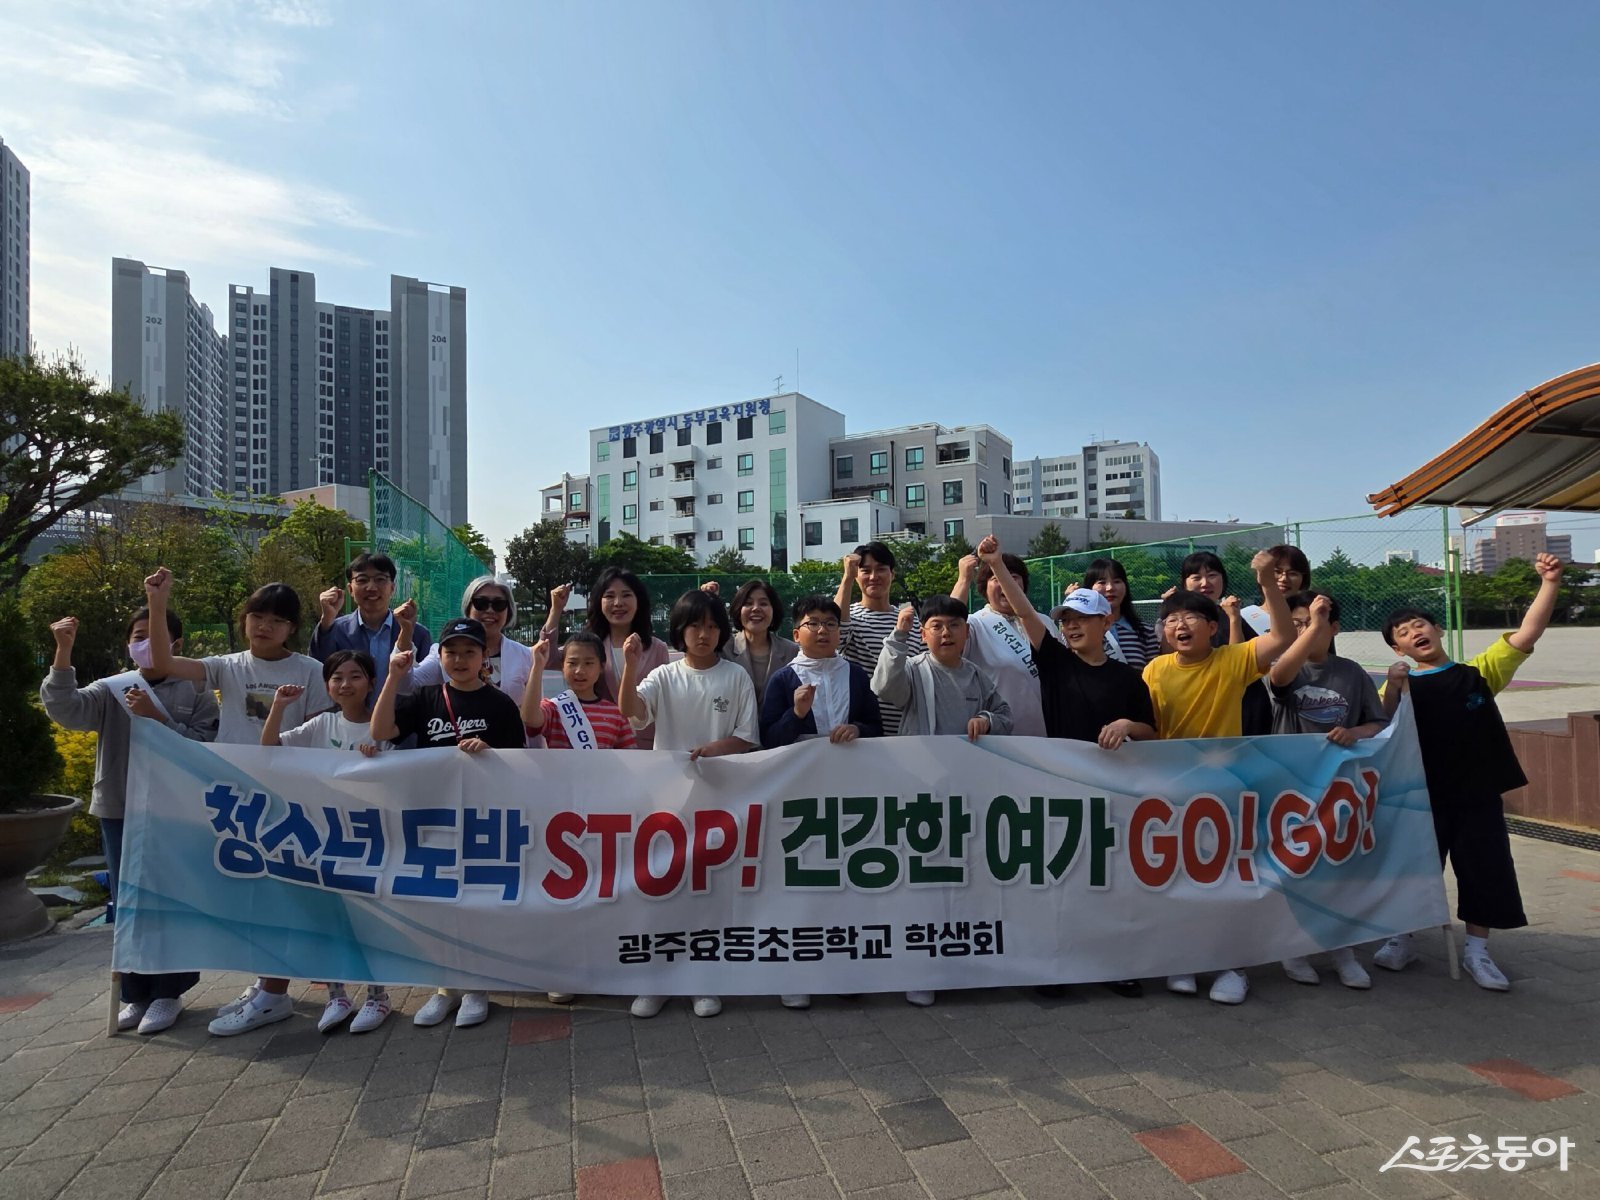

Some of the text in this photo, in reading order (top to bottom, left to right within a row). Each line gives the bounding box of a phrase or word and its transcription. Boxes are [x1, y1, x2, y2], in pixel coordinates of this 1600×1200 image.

[145, 316, 163, 326] 202
[431, 335, 447, 344] 204
[622, 398, 771, 439] 광주광역시 동부교육지원청
[561, 701, 583, 728] 여가
[204, 770, 1380, 901] 청소년 도박 STOP! 건강한 여가 GO! GO!
[617, 920, 1005, 965] 광주효동초등학교 학생회
